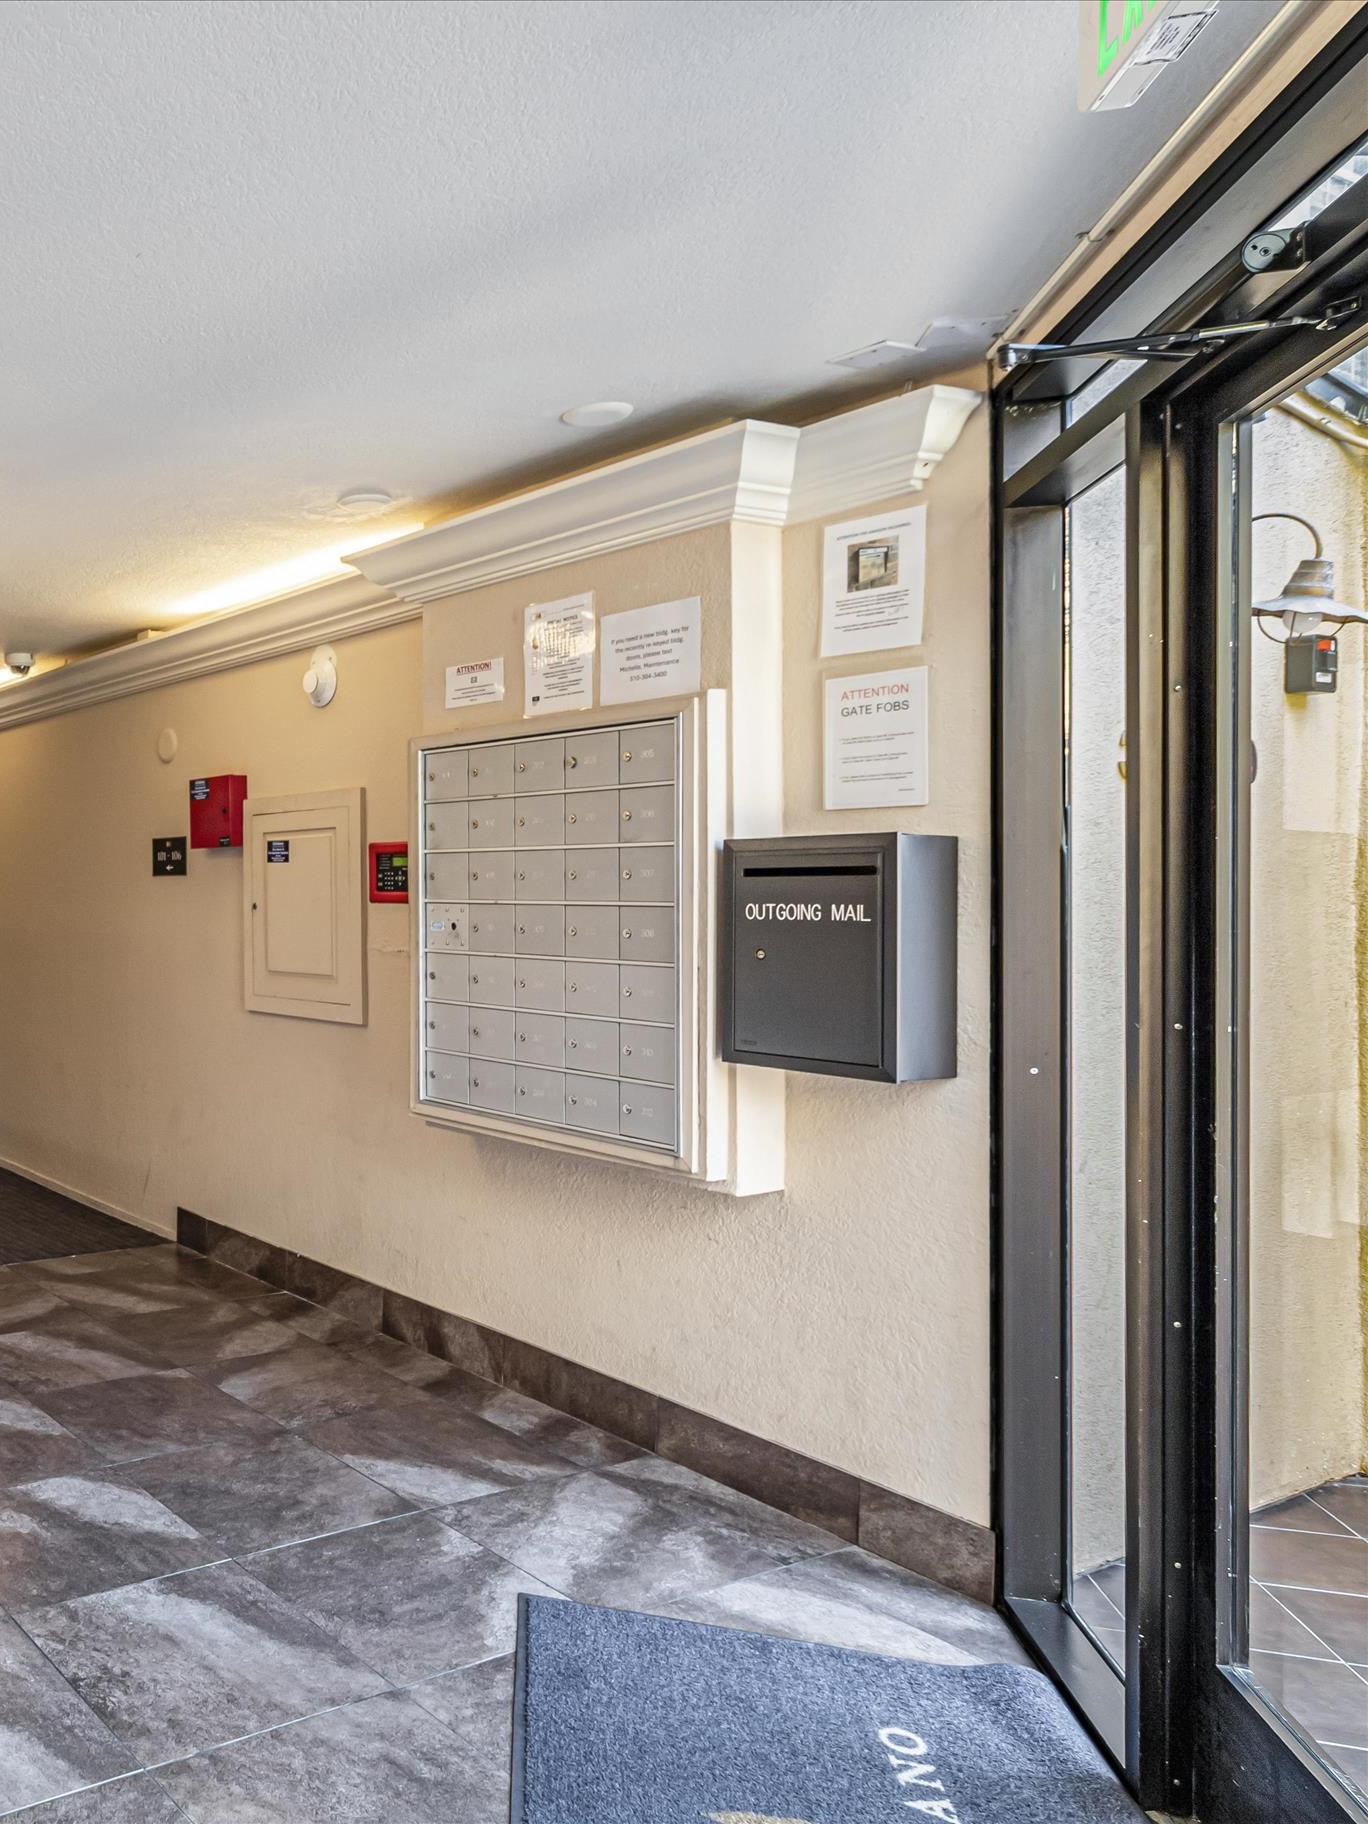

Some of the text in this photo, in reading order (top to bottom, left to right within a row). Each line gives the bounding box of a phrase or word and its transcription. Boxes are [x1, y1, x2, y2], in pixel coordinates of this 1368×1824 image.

[456, 661, 492, 674] ATTENTION!
[840, 684, 910, 701] ATTENTION
[841, 700, 910, 717] GATE FOBS
[745, 903, 872, 922] OUTGOING MAIL
